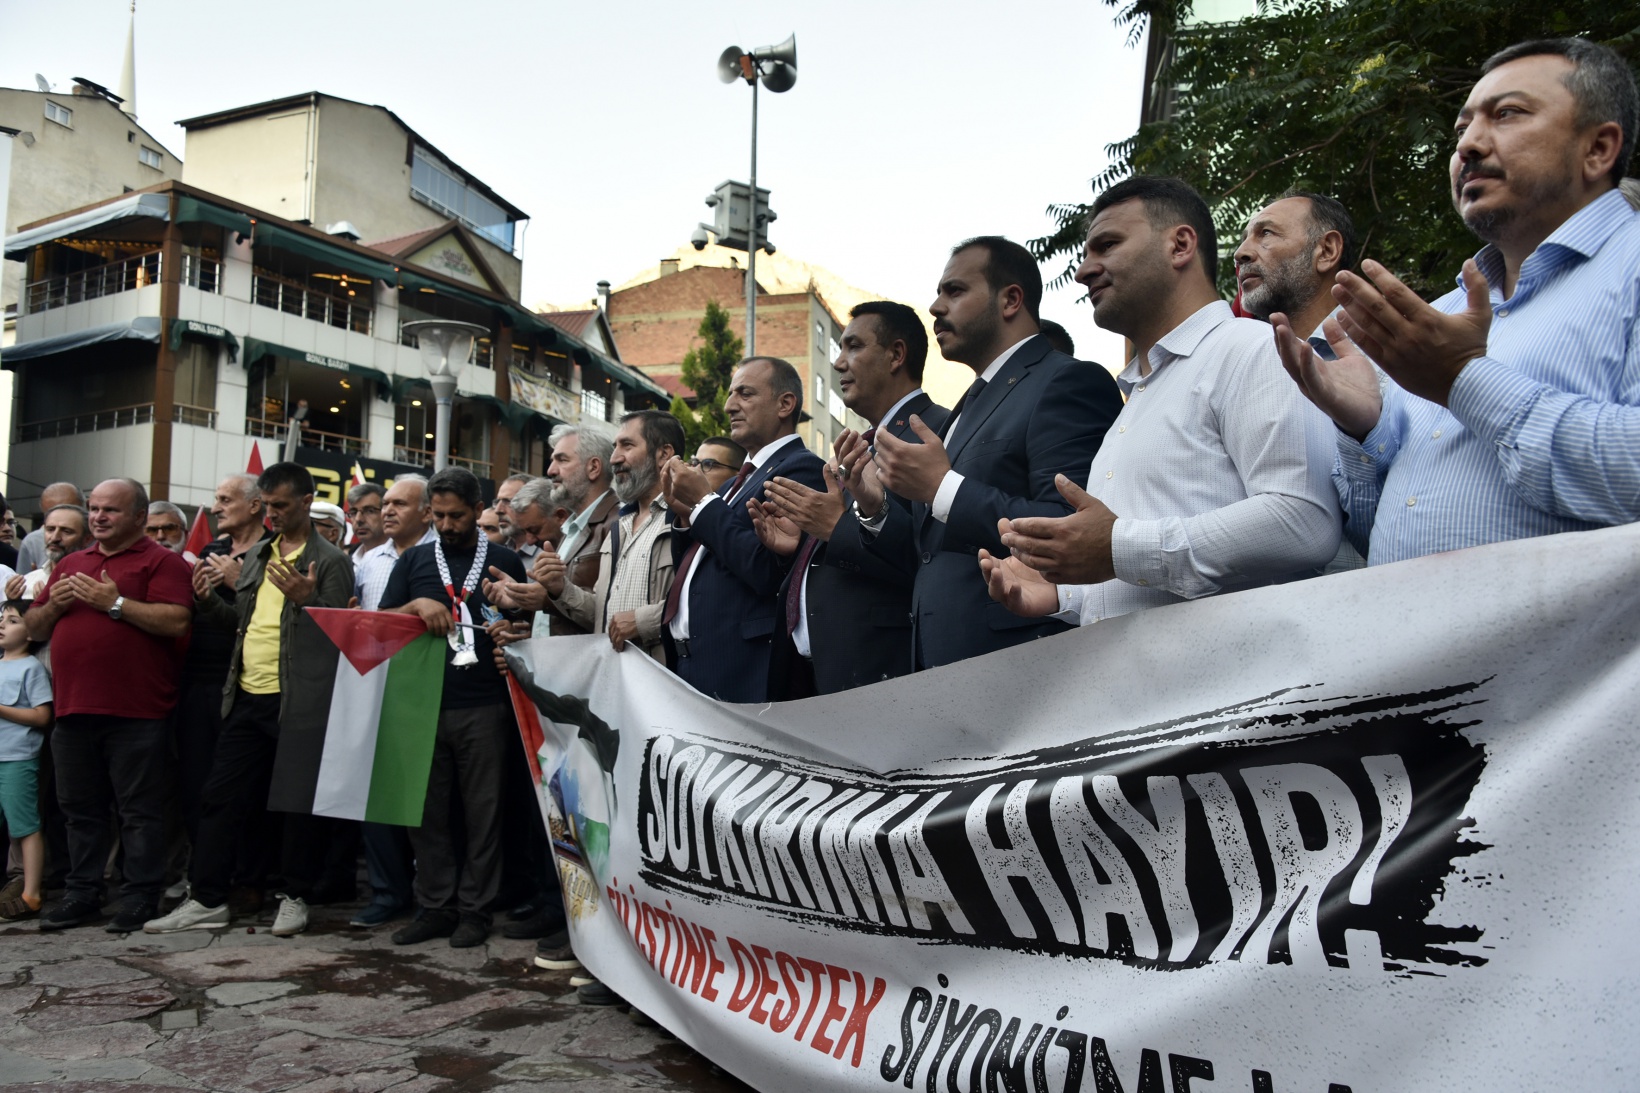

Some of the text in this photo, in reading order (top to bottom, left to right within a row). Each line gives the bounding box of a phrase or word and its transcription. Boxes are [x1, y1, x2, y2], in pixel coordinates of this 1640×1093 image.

[646, 734, 1413, 975] SOYKIRIMA HAYIR!
[606, 876, 725, 1002] İİSTİNE
[726, 936, 887, 1069] DESTEK
